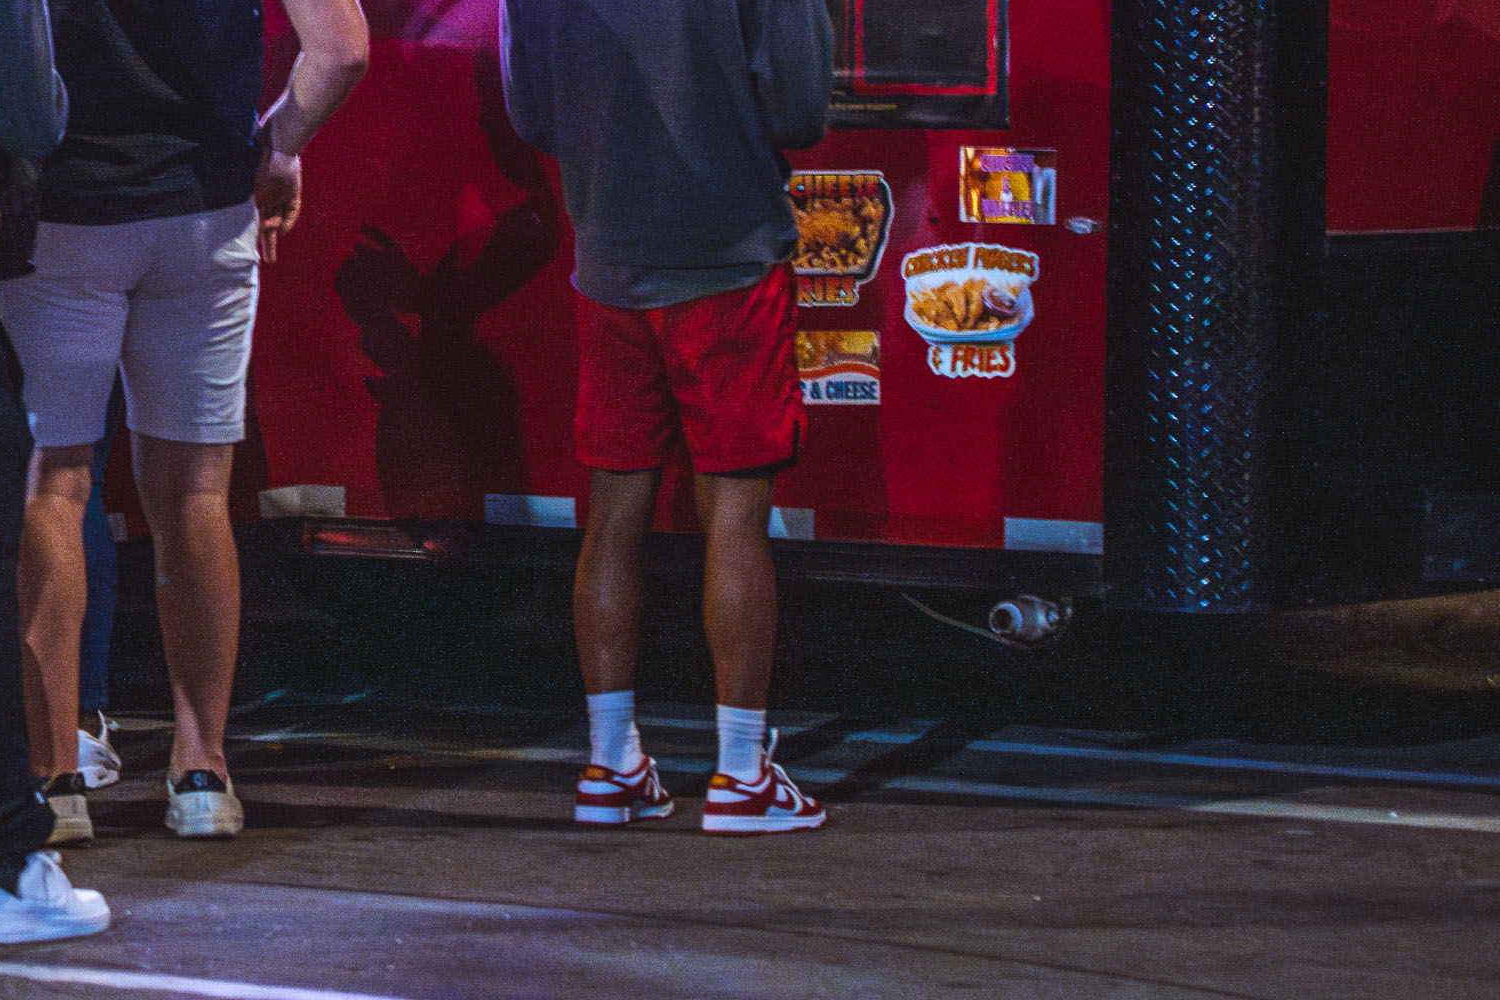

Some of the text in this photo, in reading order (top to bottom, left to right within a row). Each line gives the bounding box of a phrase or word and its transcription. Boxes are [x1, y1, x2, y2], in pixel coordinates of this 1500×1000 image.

[796, 275, 857, 303] RIES
[950, 343, 1011, 374] FRIES
[826, 381, 879, 400] CHEESE
